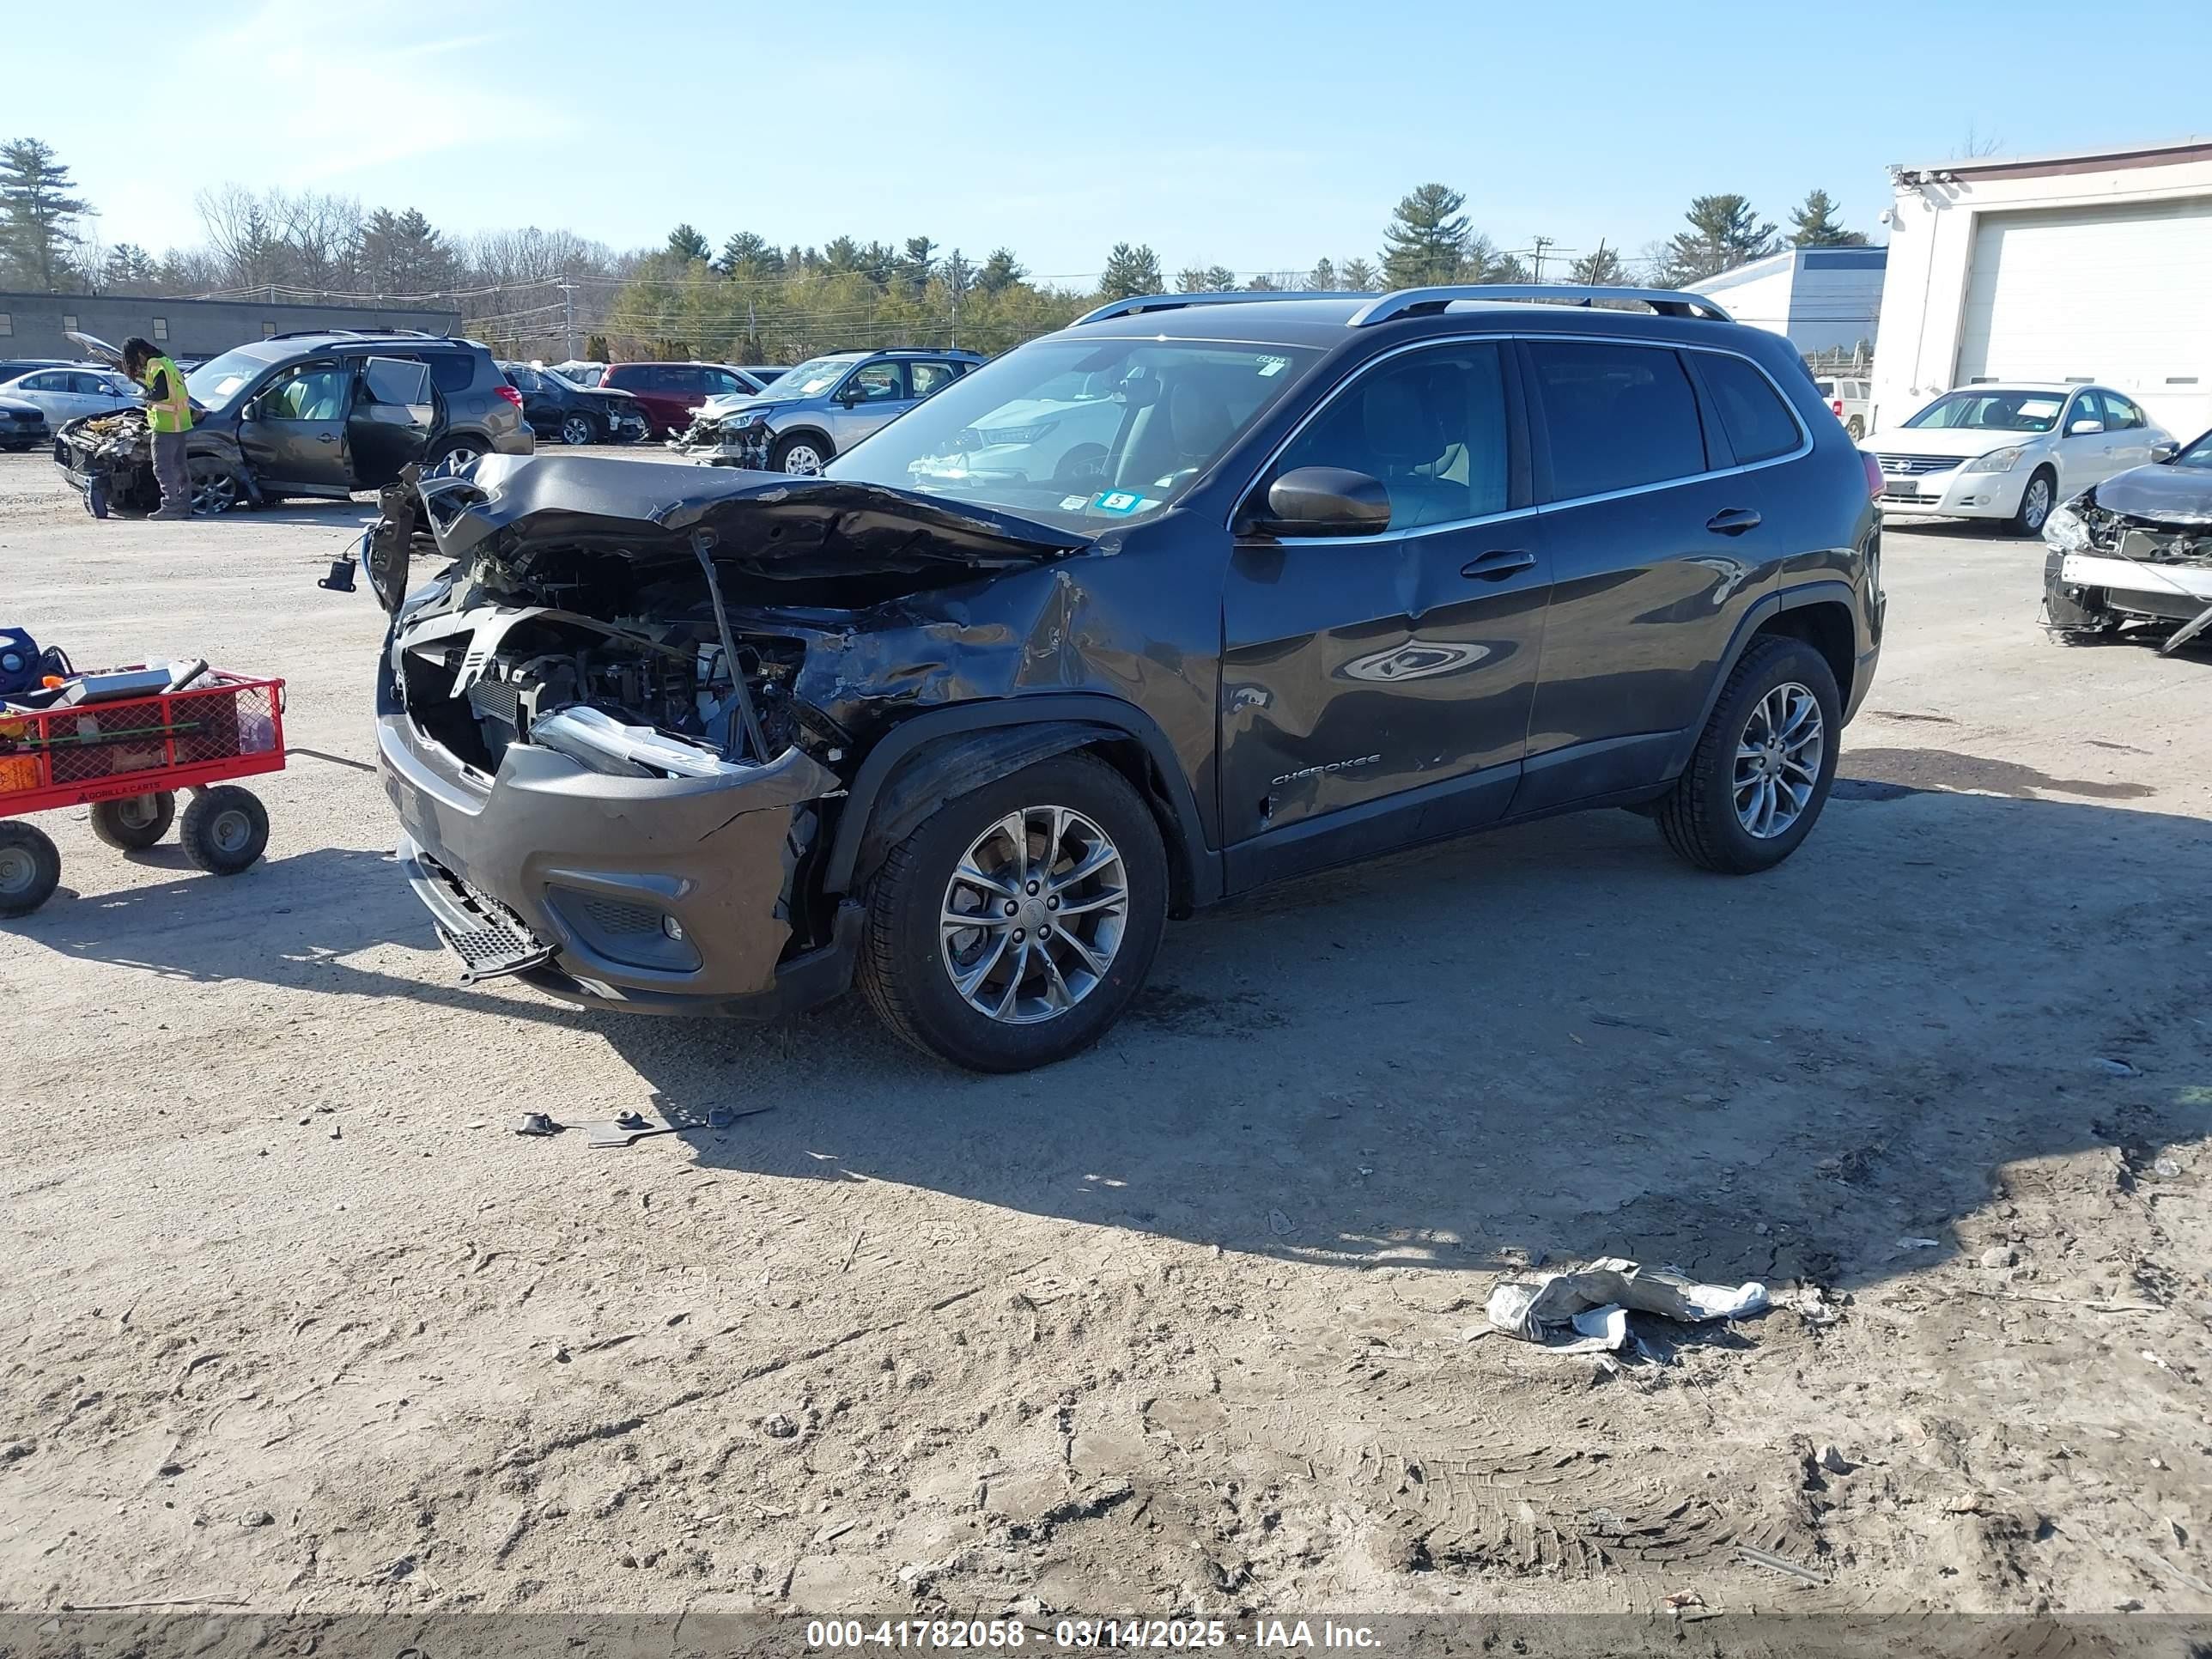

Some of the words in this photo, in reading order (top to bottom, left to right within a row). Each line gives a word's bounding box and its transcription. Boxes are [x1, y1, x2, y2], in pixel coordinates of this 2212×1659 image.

[1110, 495, 1123, 506] 5
[1271, 754, 1382, 786] CHEROKEE
[88, 787, 129, 799] GORILLA
[130, 781, 161, 793] CARTS
